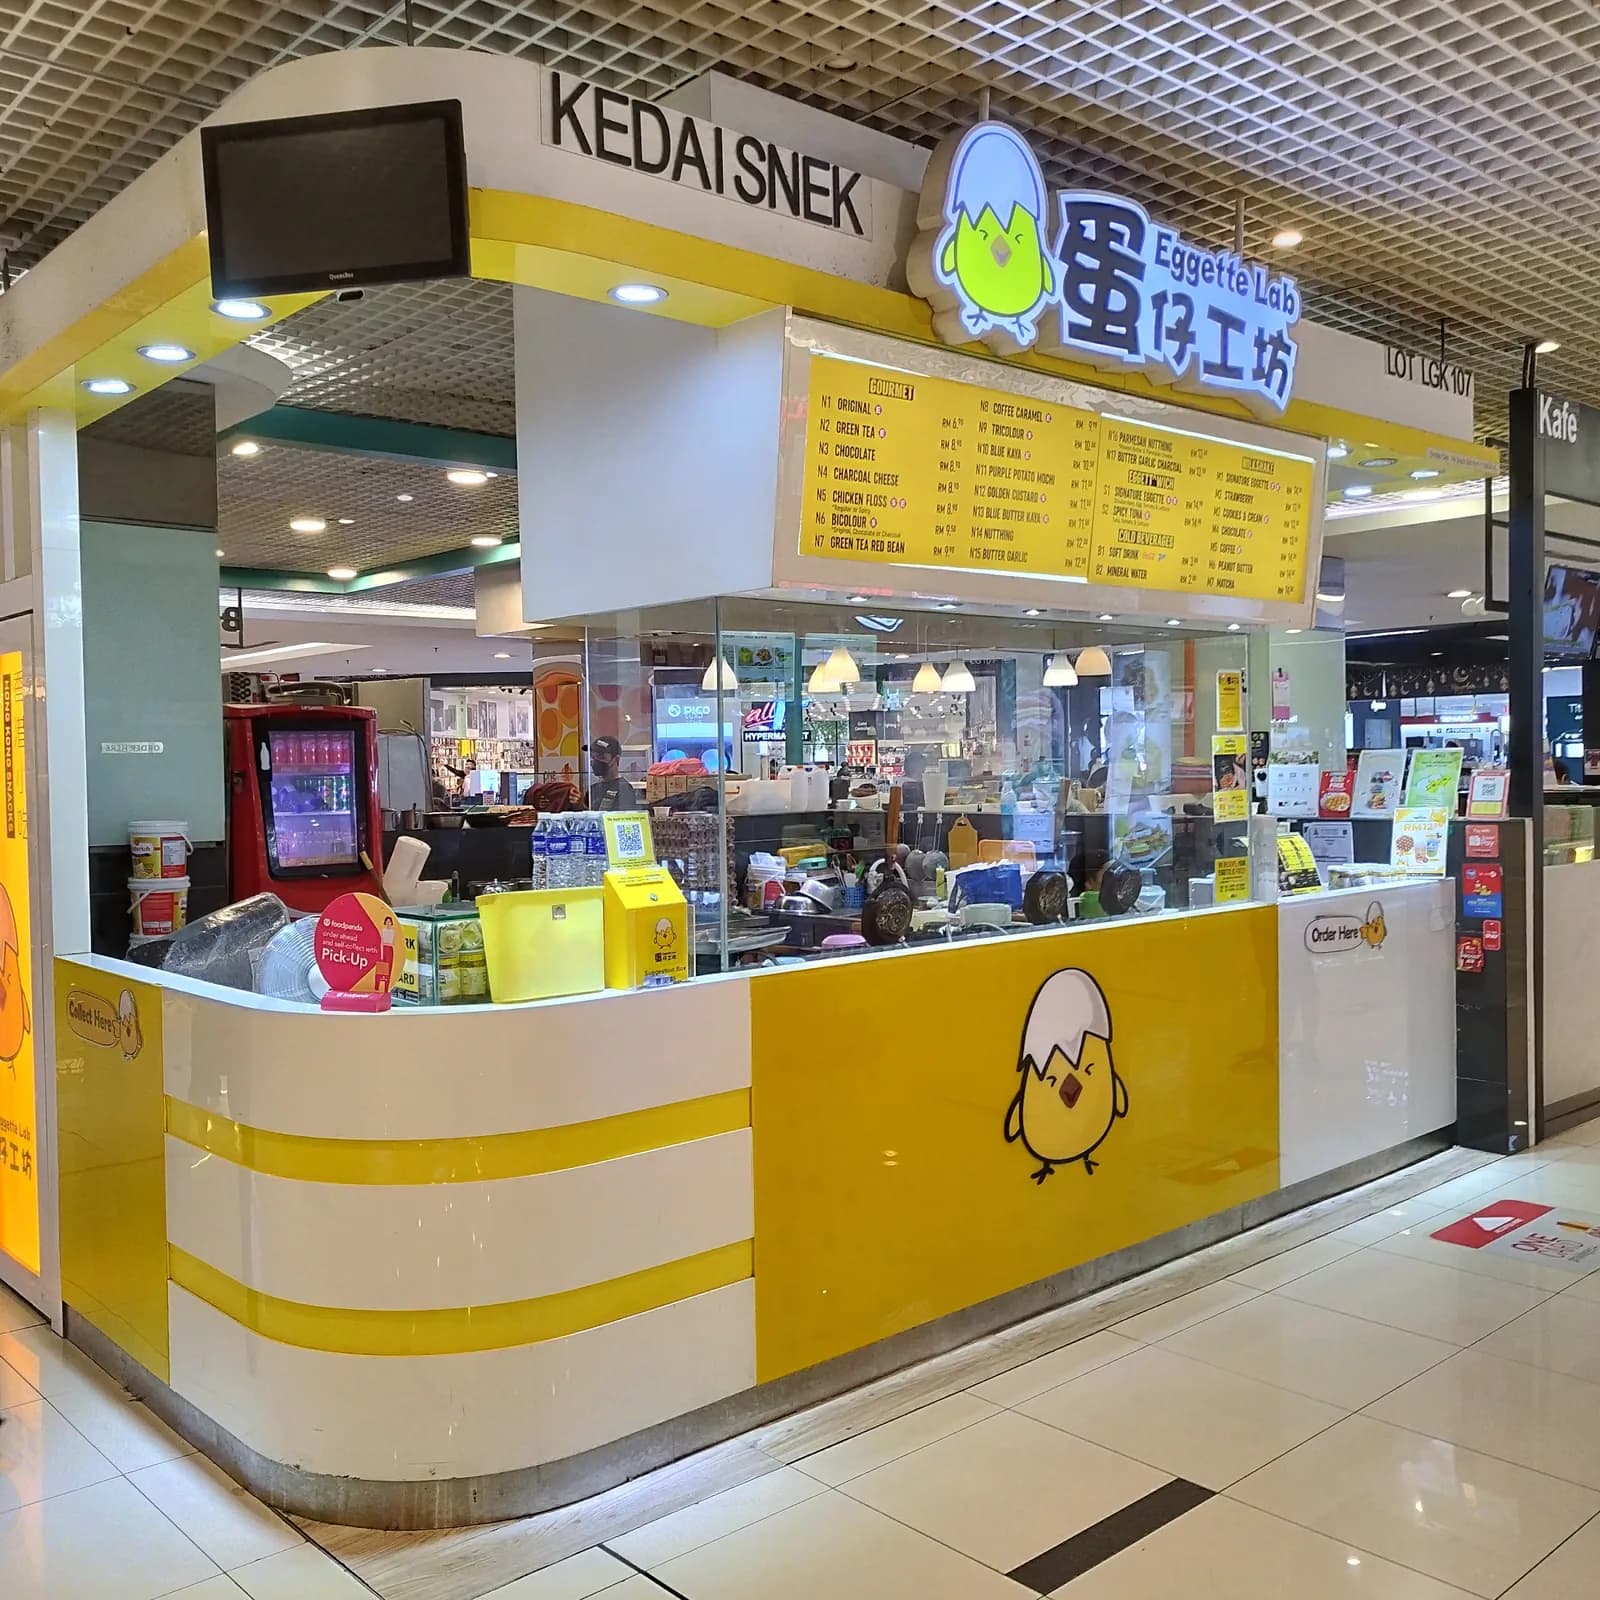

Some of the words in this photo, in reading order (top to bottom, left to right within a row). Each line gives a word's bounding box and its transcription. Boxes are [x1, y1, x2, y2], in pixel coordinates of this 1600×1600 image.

[552, 72, 724, 194] KEDAI
[734, 136, 864, 235] SNEK
[1155, 231, 1248, 296] Eggette
[1255, 271, 1296, 316] Lab
[1387, 346, 1415, 380] LOT
[1421, 358, 1449, 391] LGK
[1451, 369, 1472, 397] 107
[869, 377, 914, 400] GOURMET
[821, 395, 831, 408] N1
[837, 398, 871, 415] ORIGINAL
[980, 400, 988, 412] N8
[993, 402, 1014, 418] COFFEE
[1016, 408, 1043, 422] CARAMEL
[942, 418, 950, 428] RM
[1540, 393, 1578, 443] Kafe
[820, 418, 830, 432] N2
[836, 421, 859, 436] GREEN
[862, 425, 875, 438] TEA
[978, 422, 988, 432] N9
[992, 424, 1024, 440] TRICOLOUR
[941, 440, 950, 450] RM
[1119, 432, 1146, 446] PARMESAN
[818, 441, 828, 455] N3
[835, 444, 876, 461] CHOCOLATE
[978, 442, 988, 454] N10
[990, 444, 1004, 457] BLUE
[1006, 447, 1022, 460] KAYA
[1118, 451, 1138, 464] BUTTER
[1138, 456, 1156, 468] GARLIC
[940, 462, 949, 472] RM
[976, 464, 987, 476] N11
[989, 466, 1012, 479] PURPLE
[1013, 468, 1035, 482] POTATO
[1037, 472, 1056, 485] MOCHI
[818, 466, 828, 478] N4
[834, 467, 871, 484] CHARCOAL
[874, 472, 899, 486] CHEESE
[938, 483, 946, 492] RM
[974, 485, 986, 497] N12
[987, 486, 1010, 500] GOLDEN
[1012, 489, 1038, 502] CUSTARD
[1114, 486, 1142, 500] SIGNATURE
[1144, 490, 1164, 504] EGGETTE
[816, 489, 826, 502] N5
[832, 490, 864, 505] CHICKEN
[866, 494, 888, 508] FLOSS
[936, 504, 944, 514] RM
[972, 506, 984, 518] N13
[986, 506, 1000, 520] BLUE
[1002, 508, 1024, 522] BUTTER
[1026, 511, 1040, 523] KAYA
[1113, 506, 1128, 518] SPICY
[1130, 508, 1142, 519] TUNA
[816, 512, 825, 525] N6
[832, 513, 866, 528] BICOLOUR
[935, 526, 944, 536] RM
[971, 527, 982, 539] N14
[984, 528, 1014, 541] NUTTHING
[1119, 530, 1136, 544] COLD
[1137, 531, 1174, 548] BEVERAGES
[815, 535, 824, 548] N7
[830, 536, 854, 550] GREEN
[856, 538, 868, 552] TEA
[871, 540, 884, 552] RED
[887, 541, 905, 554] BEAN
[934, 546, 942, 556] RM
[970, 548, 981, 560] N15
[982, 548, 1006, 561] BUTTER
[1006, 550, 1028, 563] GARLIC
[1109, 547, 1122, 559] SOFT
[1123, 548, 1138, 560] DRINK
[1107, 566, 1130, 578] MINERAL
[1131, 569, 1148, 580] WATER
[744, 731, 810, 741] HYPERMAT
[6, 768, 15, 834] SNACKS
[331, 920, 362, 932] foodpanda
[1312, 927, 1336, 942] Order
[1339, 925, 1359, 940] Here
[340, 934, 358, 942] ahead
[334, 942, 364, 952] self-collect
[366, 946, 378, 954] with
[322, 948, 368, 970] Pick-Up
[69, 1000, 92, 1025] Collect
[94, 1009, 112, 1032] Here
